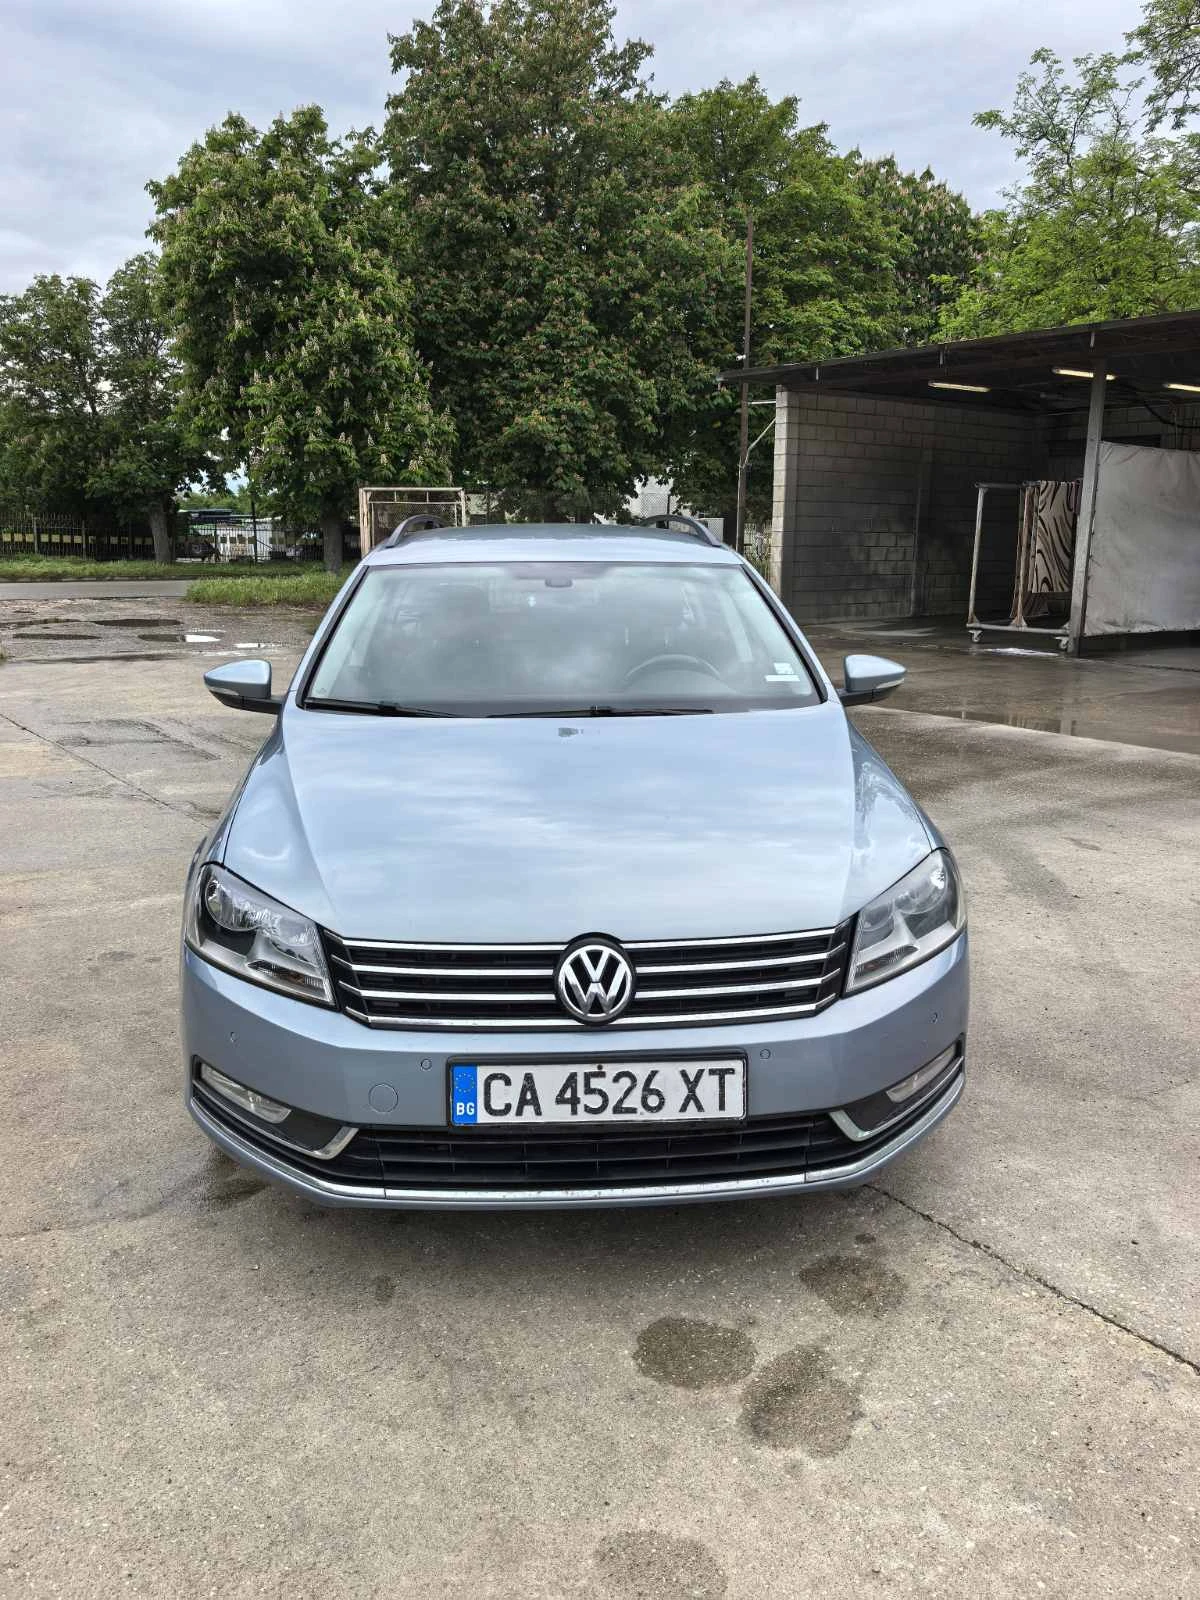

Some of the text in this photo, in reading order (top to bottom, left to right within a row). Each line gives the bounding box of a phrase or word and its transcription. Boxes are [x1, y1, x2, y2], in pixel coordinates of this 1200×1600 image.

[559, 945, 632, 1017] VW
[456, 1102, 475, 1116] BG
[483, 1067, 735, 1117] CA 4526 XT
